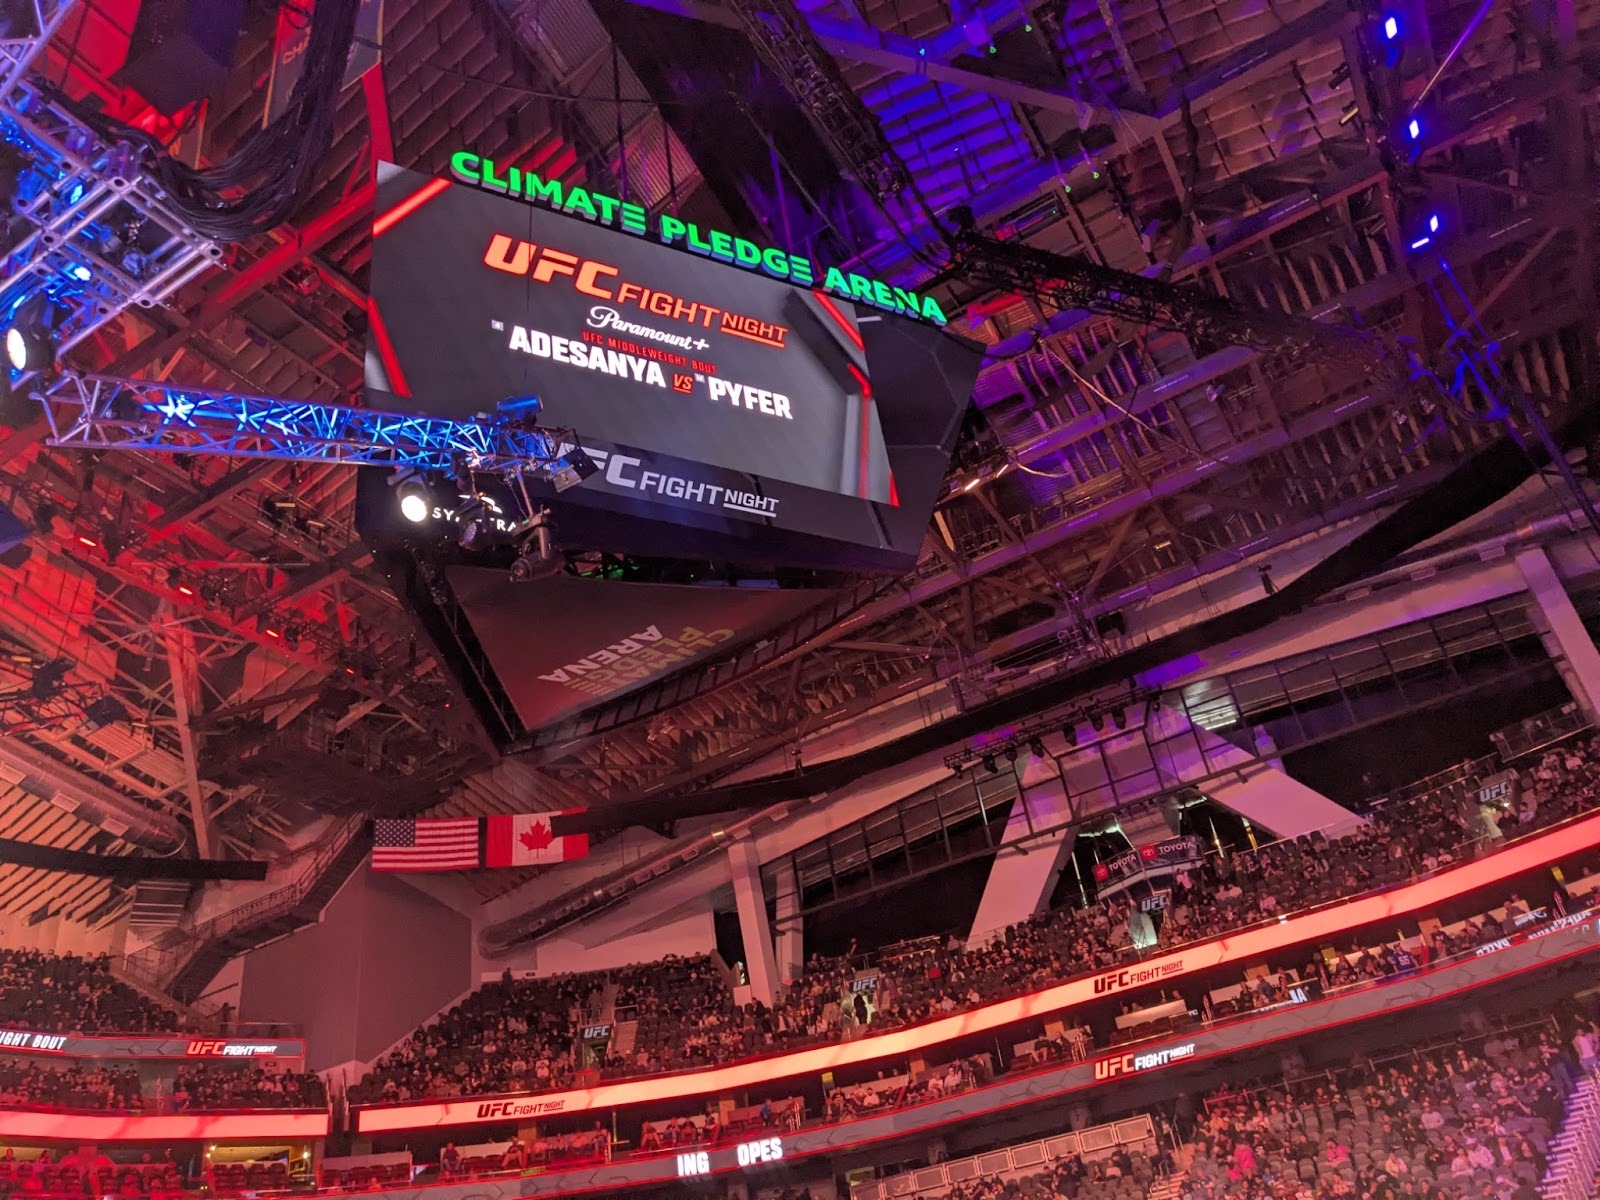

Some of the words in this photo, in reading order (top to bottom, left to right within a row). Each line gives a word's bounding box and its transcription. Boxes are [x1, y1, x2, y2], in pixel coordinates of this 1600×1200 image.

[451, 152, 647, 235] CLIMATE
[660, 214, 813, 285] PLEDGE
[822, 266, 947, 326] ARENA
[485, 234, 619, 299] UFC
[618, 282, 720, 328] FIGHT
[720, 311, 788, 346] NIGHT
[586, 306, 710, 350] Paramount+
[582, 331, 604, 345] UFC
[608, 337, 687, 367] MIDDLEWEIGHT
[691, 360, 717, 375] BOUT
[508, 325, 667, 388] ADESANYA
[673, 373, 693, 392] VS
[708, 376, 793, 420] PYFER
[640, 471, 724, 506] FIGHT
[724, 488, 780, 514] NIGHT
[537, 625, 663, 684] ARENA
[1108, 853, 1137, 872] TOYOTA
[1157, 841, 1196, 854] TOYOTA
[853, 977, 878, 992] UFC
[1094, 970, 1130, 994] UFC
[1130, 966, 1161, 985] FIGHT
[1161, 960, 1184, 974] NIGHT
[32, 1034, 67, 1050] BOUT
[187, 1041, 226, 1055] UFC
[222, 1046, 255, 1056] FIGHT
[254, 1046, 278, 1054] NIGHT
[584, 1025, 610, 1039] UFC
[1094, 1053, 1135, 1080] UFC
[1134, 1050, 1170, 1071] FIGHT
[1169, 1043, 1196, 1060] NIGHT
[477, 1102, 514, 1118] UFC
[513, 1103, 545, 1116] FIGHT
[544, 1100, 566, 1110] NIGHT
[677, 1151, 710, 1176] ING
[737, 1137, 783, 1167] OPES
